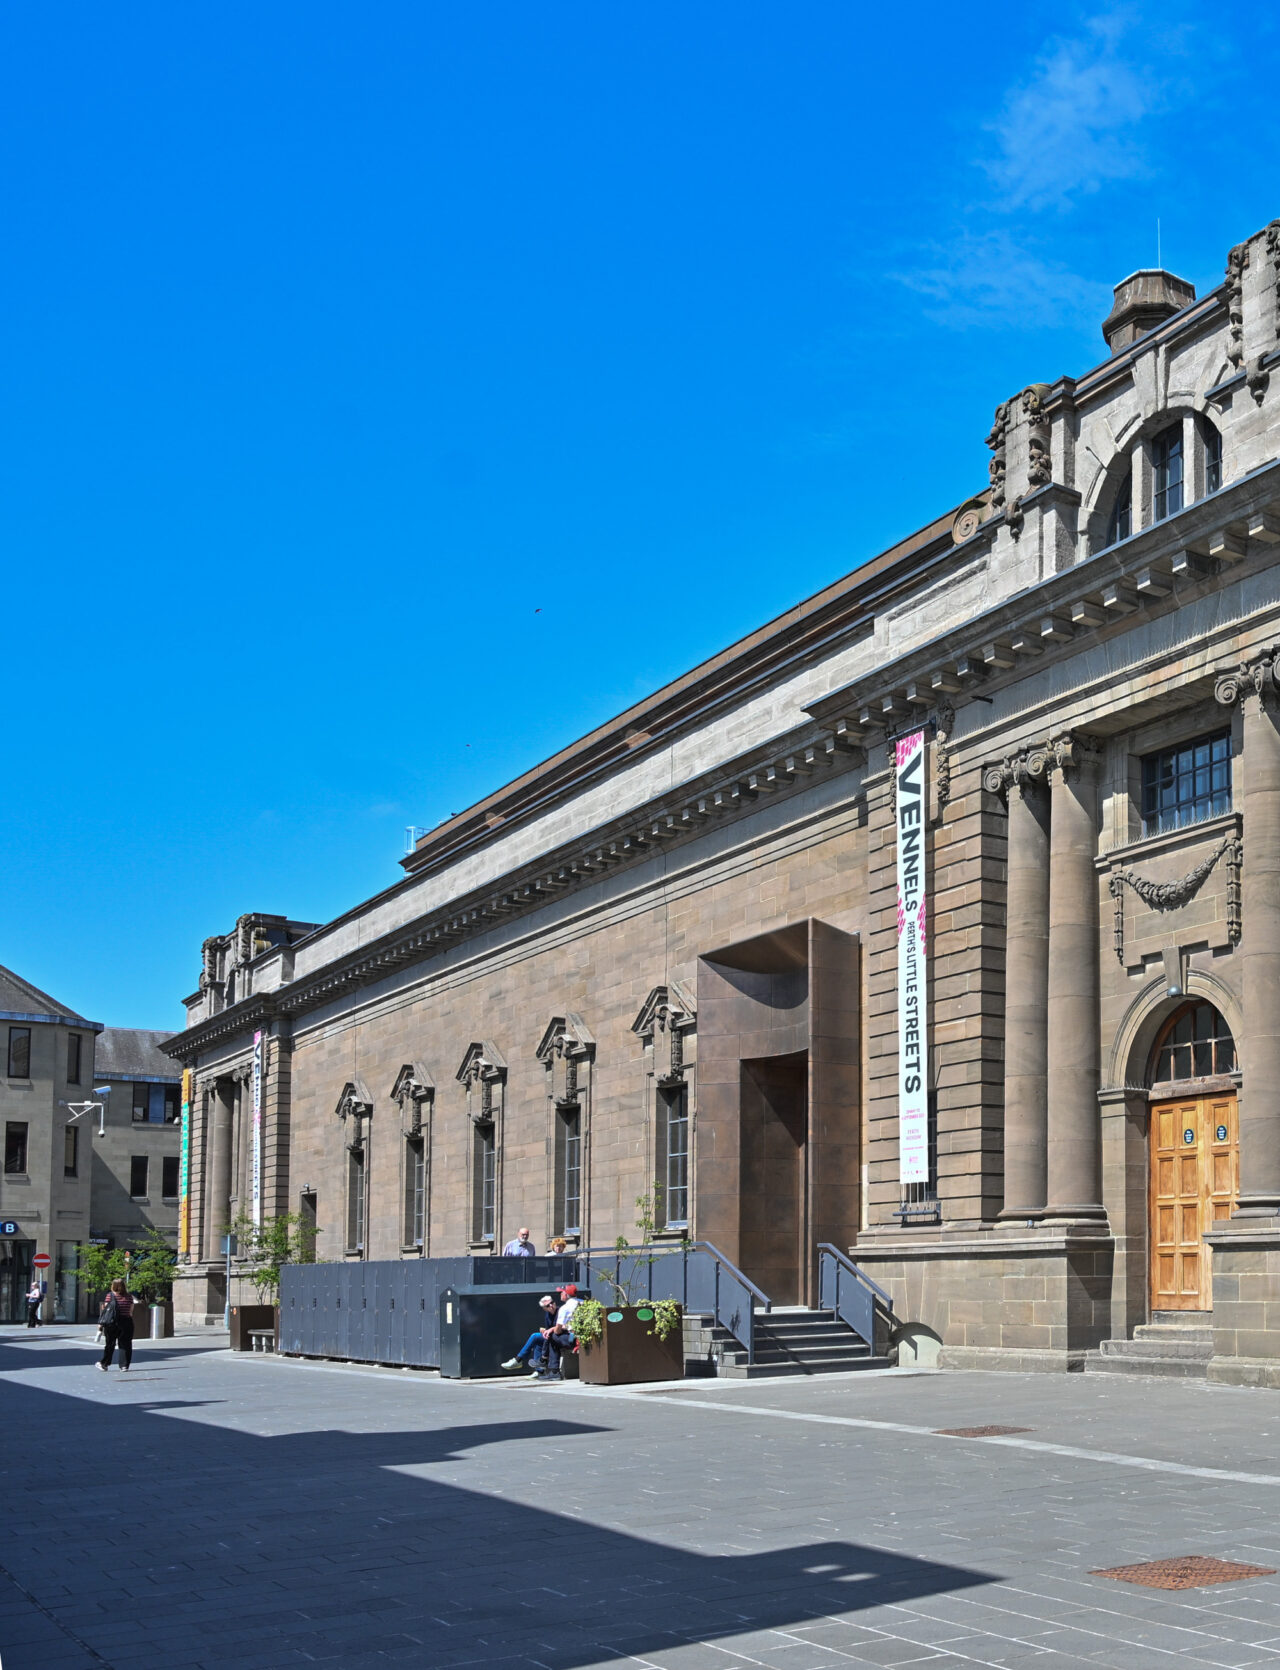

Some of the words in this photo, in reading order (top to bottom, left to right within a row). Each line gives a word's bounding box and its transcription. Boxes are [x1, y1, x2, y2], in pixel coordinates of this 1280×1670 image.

[898, 751, 922, 912] VENNELS
[906, 954, 917, 993] LITTLE
[905, 996, 922, 1094] STREETS
[5, 1223, 15, 1233] B
